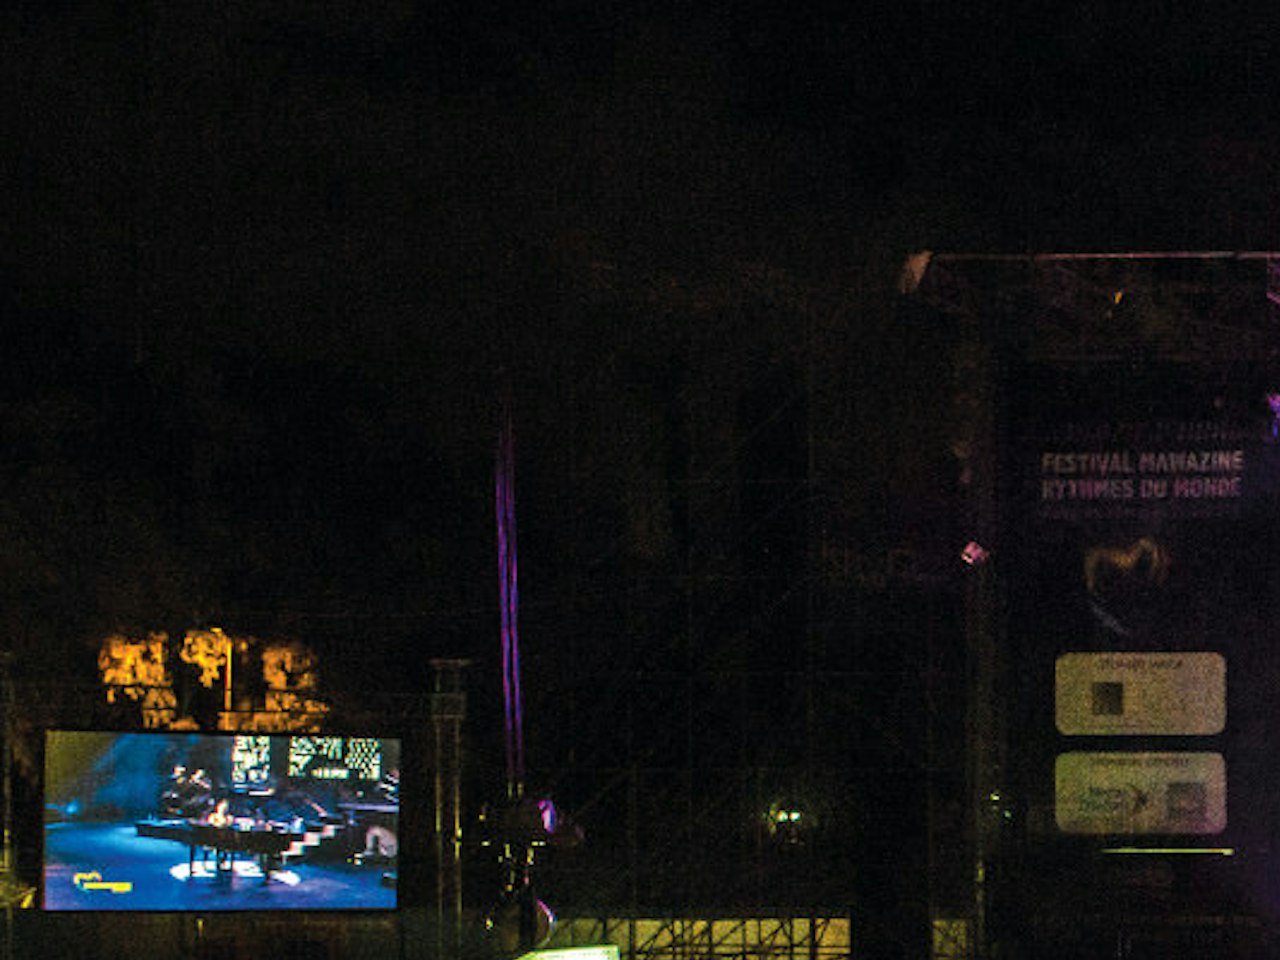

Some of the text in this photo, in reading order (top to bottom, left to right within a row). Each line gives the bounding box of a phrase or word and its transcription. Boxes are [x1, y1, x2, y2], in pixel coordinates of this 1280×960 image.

[1040, 449, 1245, 474] FESTIVAL MAWAZINE
[1139, 478, 1167, 498] DU
[1172, 476, 1243, 498] MONDE
